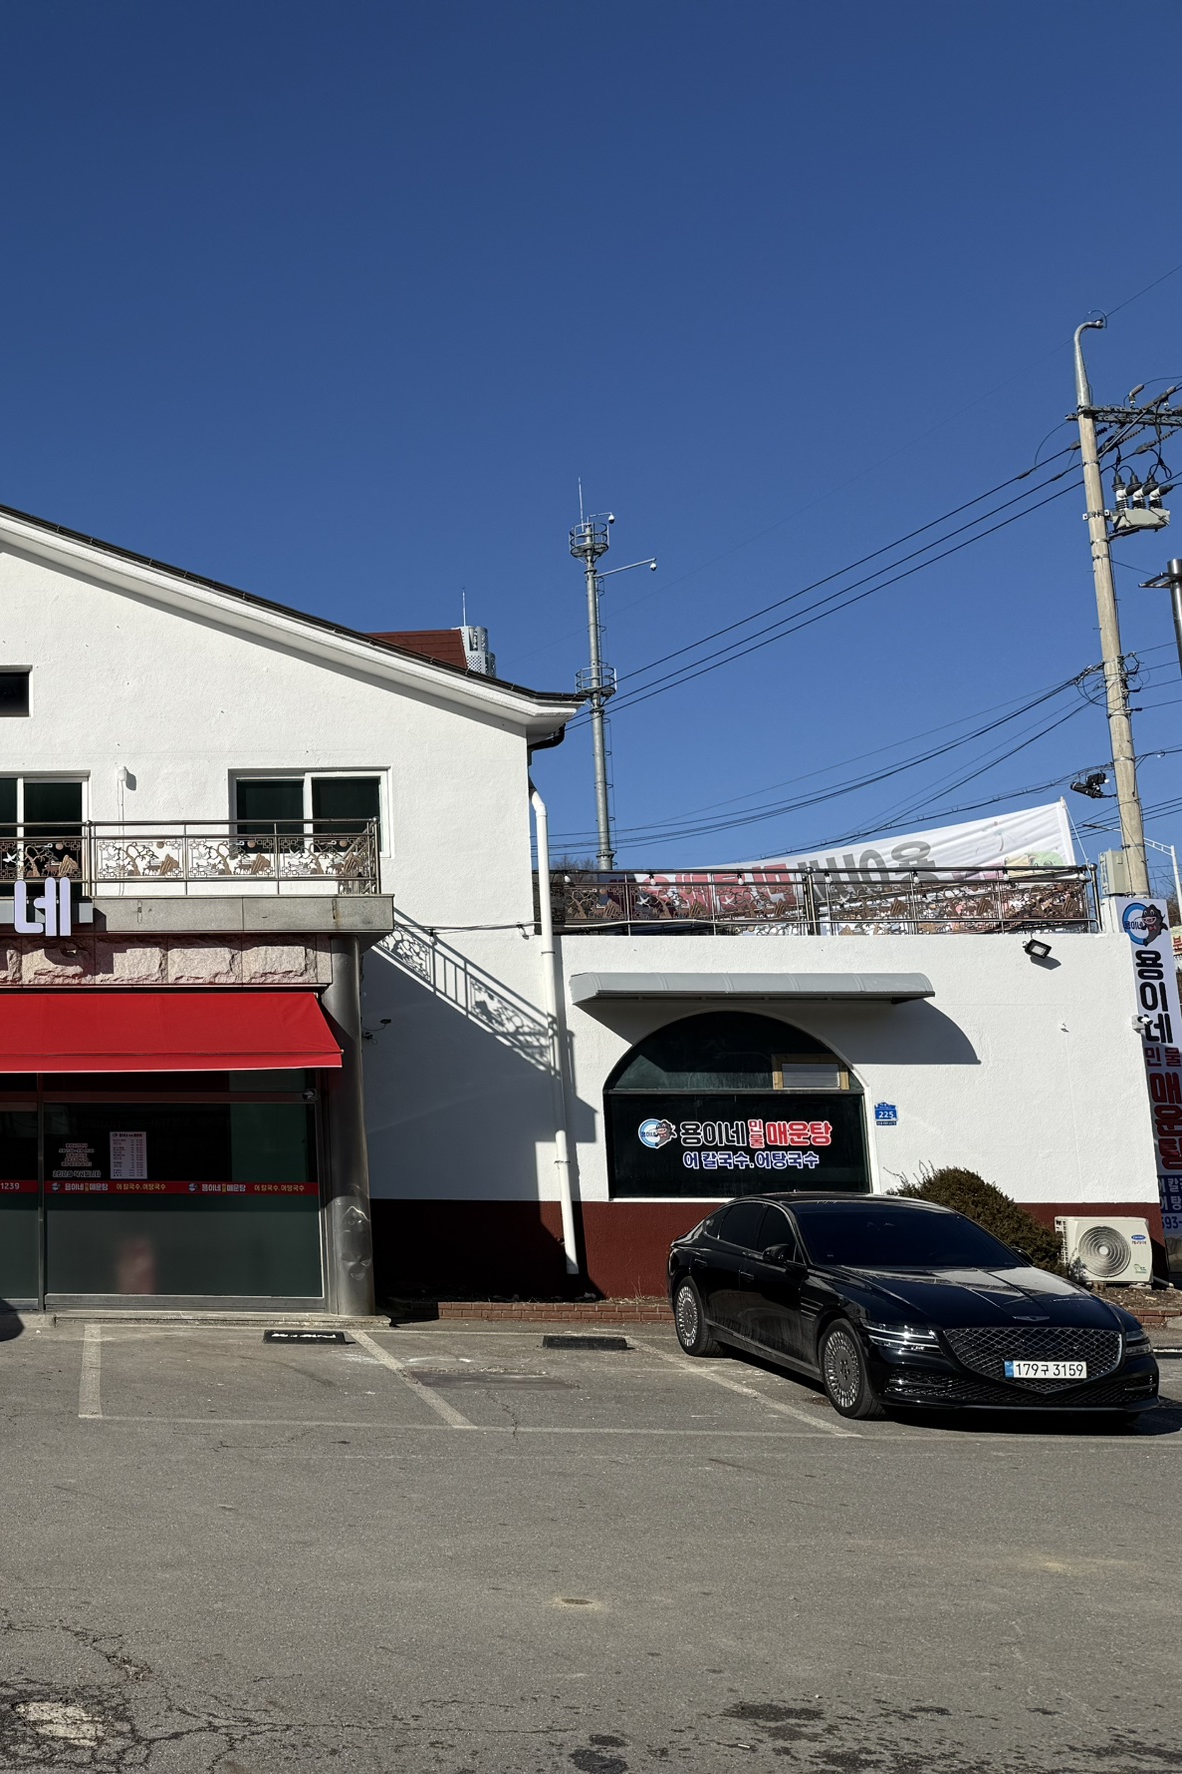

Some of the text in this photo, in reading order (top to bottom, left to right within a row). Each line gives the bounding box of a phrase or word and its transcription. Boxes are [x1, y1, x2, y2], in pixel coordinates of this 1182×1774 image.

[878, 1110, 894, 1119] 225
[680, 1121, 747, 1147] 용이네
[766, 1120, 833, 1146] 매운탕
